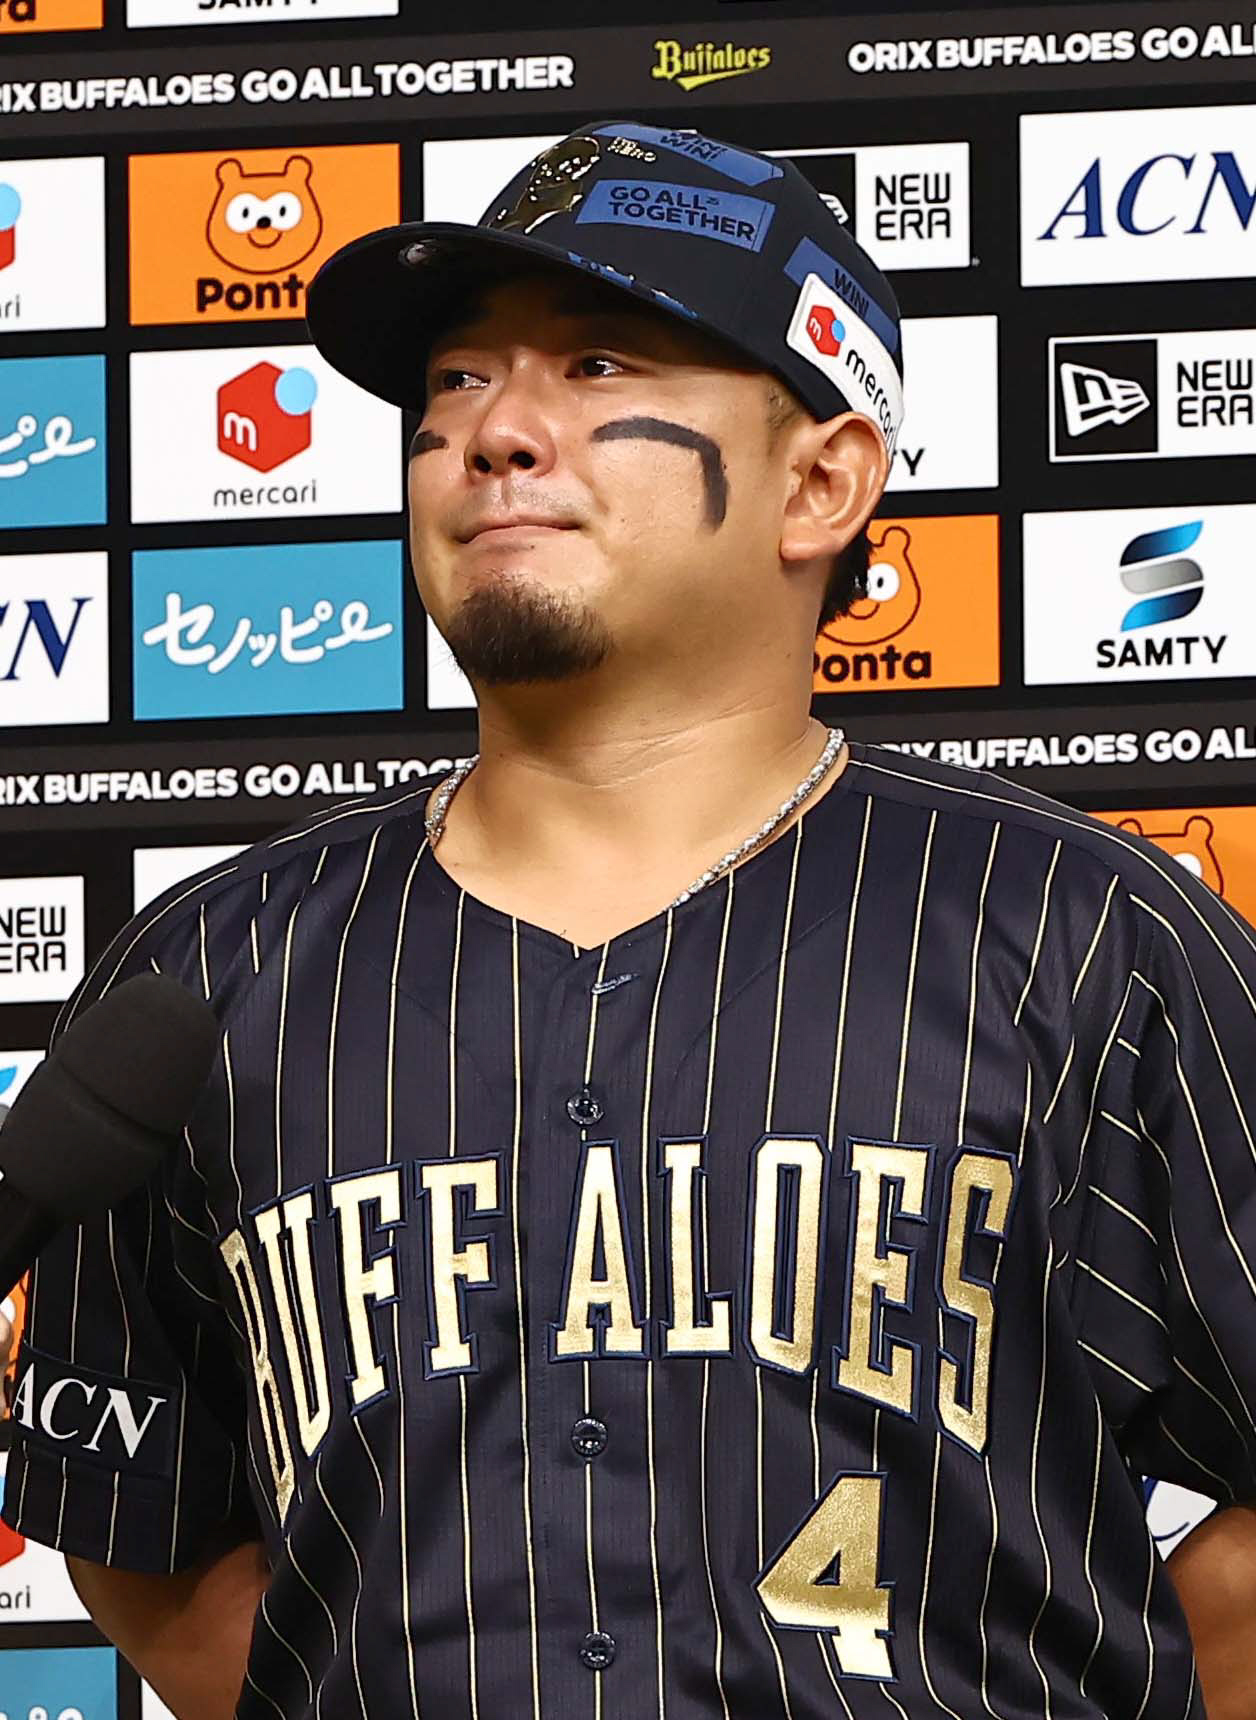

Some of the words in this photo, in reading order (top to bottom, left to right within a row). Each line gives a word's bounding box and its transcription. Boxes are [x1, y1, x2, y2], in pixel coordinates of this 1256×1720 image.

[652, 40, 771, 80] Buffaloes
[848, 40, 932, 73] ORIX
[936, 30, 1135, 69] BUFFALOES
[1141, 26, 1199, 60] GO
[1200, 24, 1256, 57] AL
[0, 82, 37, 113] IX
[40, 73, 236, 111] BUFFALOES
[241, 69, 298, 102] GO
[299, 65, 374, 99] ALL
[374, 56, 574, 96] TOGETHER
[610, 186, 650, 201] GO
[655, 190, 707, 211] ALL
[875, 172, 951, 206] NEW
[608, 201, 755, 242] TOGETHER
[875, 208, 951, 241] ERA
[196, 273, 304, 313] Pont
[1177, 358, 1253, 393] NEW
[1177, 394, 1253, 428] ERA
[213, 480, 316, 507] mercari
[1096, 635, 1227, 669] SAMTY
[939, 733, 1139, 769] BUFFALOES
[1145, 730, 1202, 762] GO
[1204, 727, 1256, 760] AL
[0, 775, 40, 805] IX
[43, 767, 239, 804] BUFFALOES
[244, 764, 301, 797] GO
[302, 761, 377, 793] ALL
[218, 1132, 1023, 1531] BUFFALOES
[12, 1362, 168, 1459] ACN
[751, 1471, 900, 1684] 4
